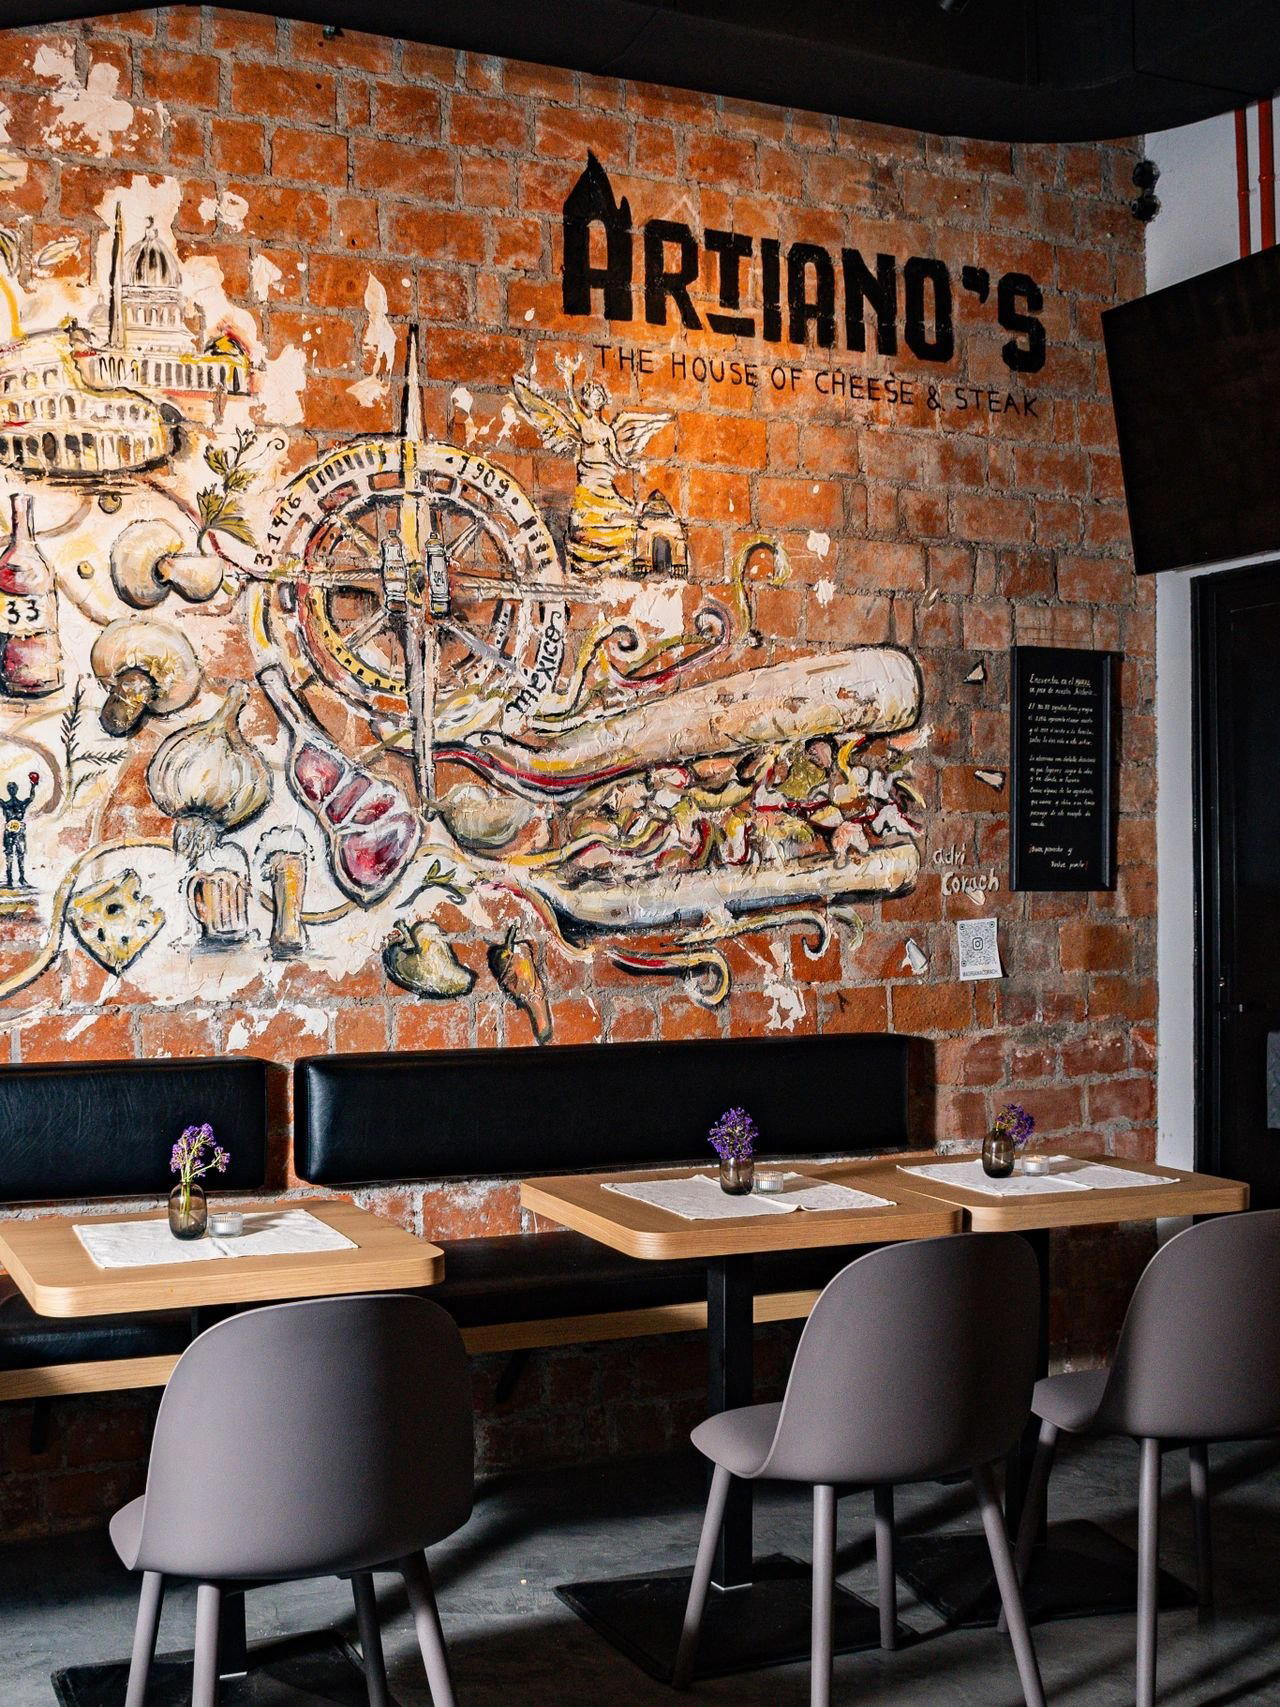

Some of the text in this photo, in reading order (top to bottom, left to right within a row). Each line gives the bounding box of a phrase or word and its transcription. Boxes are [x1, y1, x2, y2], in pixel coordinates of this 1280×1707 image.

[562, 148, 1046, 374] ARTIANO'S
[593, 344, 1040, 418] THE HOUSE OF CHEESE & STEAK
[254, 493, 301, 567] 3.1416
[7, 600, 39, 625] 33
[942, 867, 1000, 896] Corach
